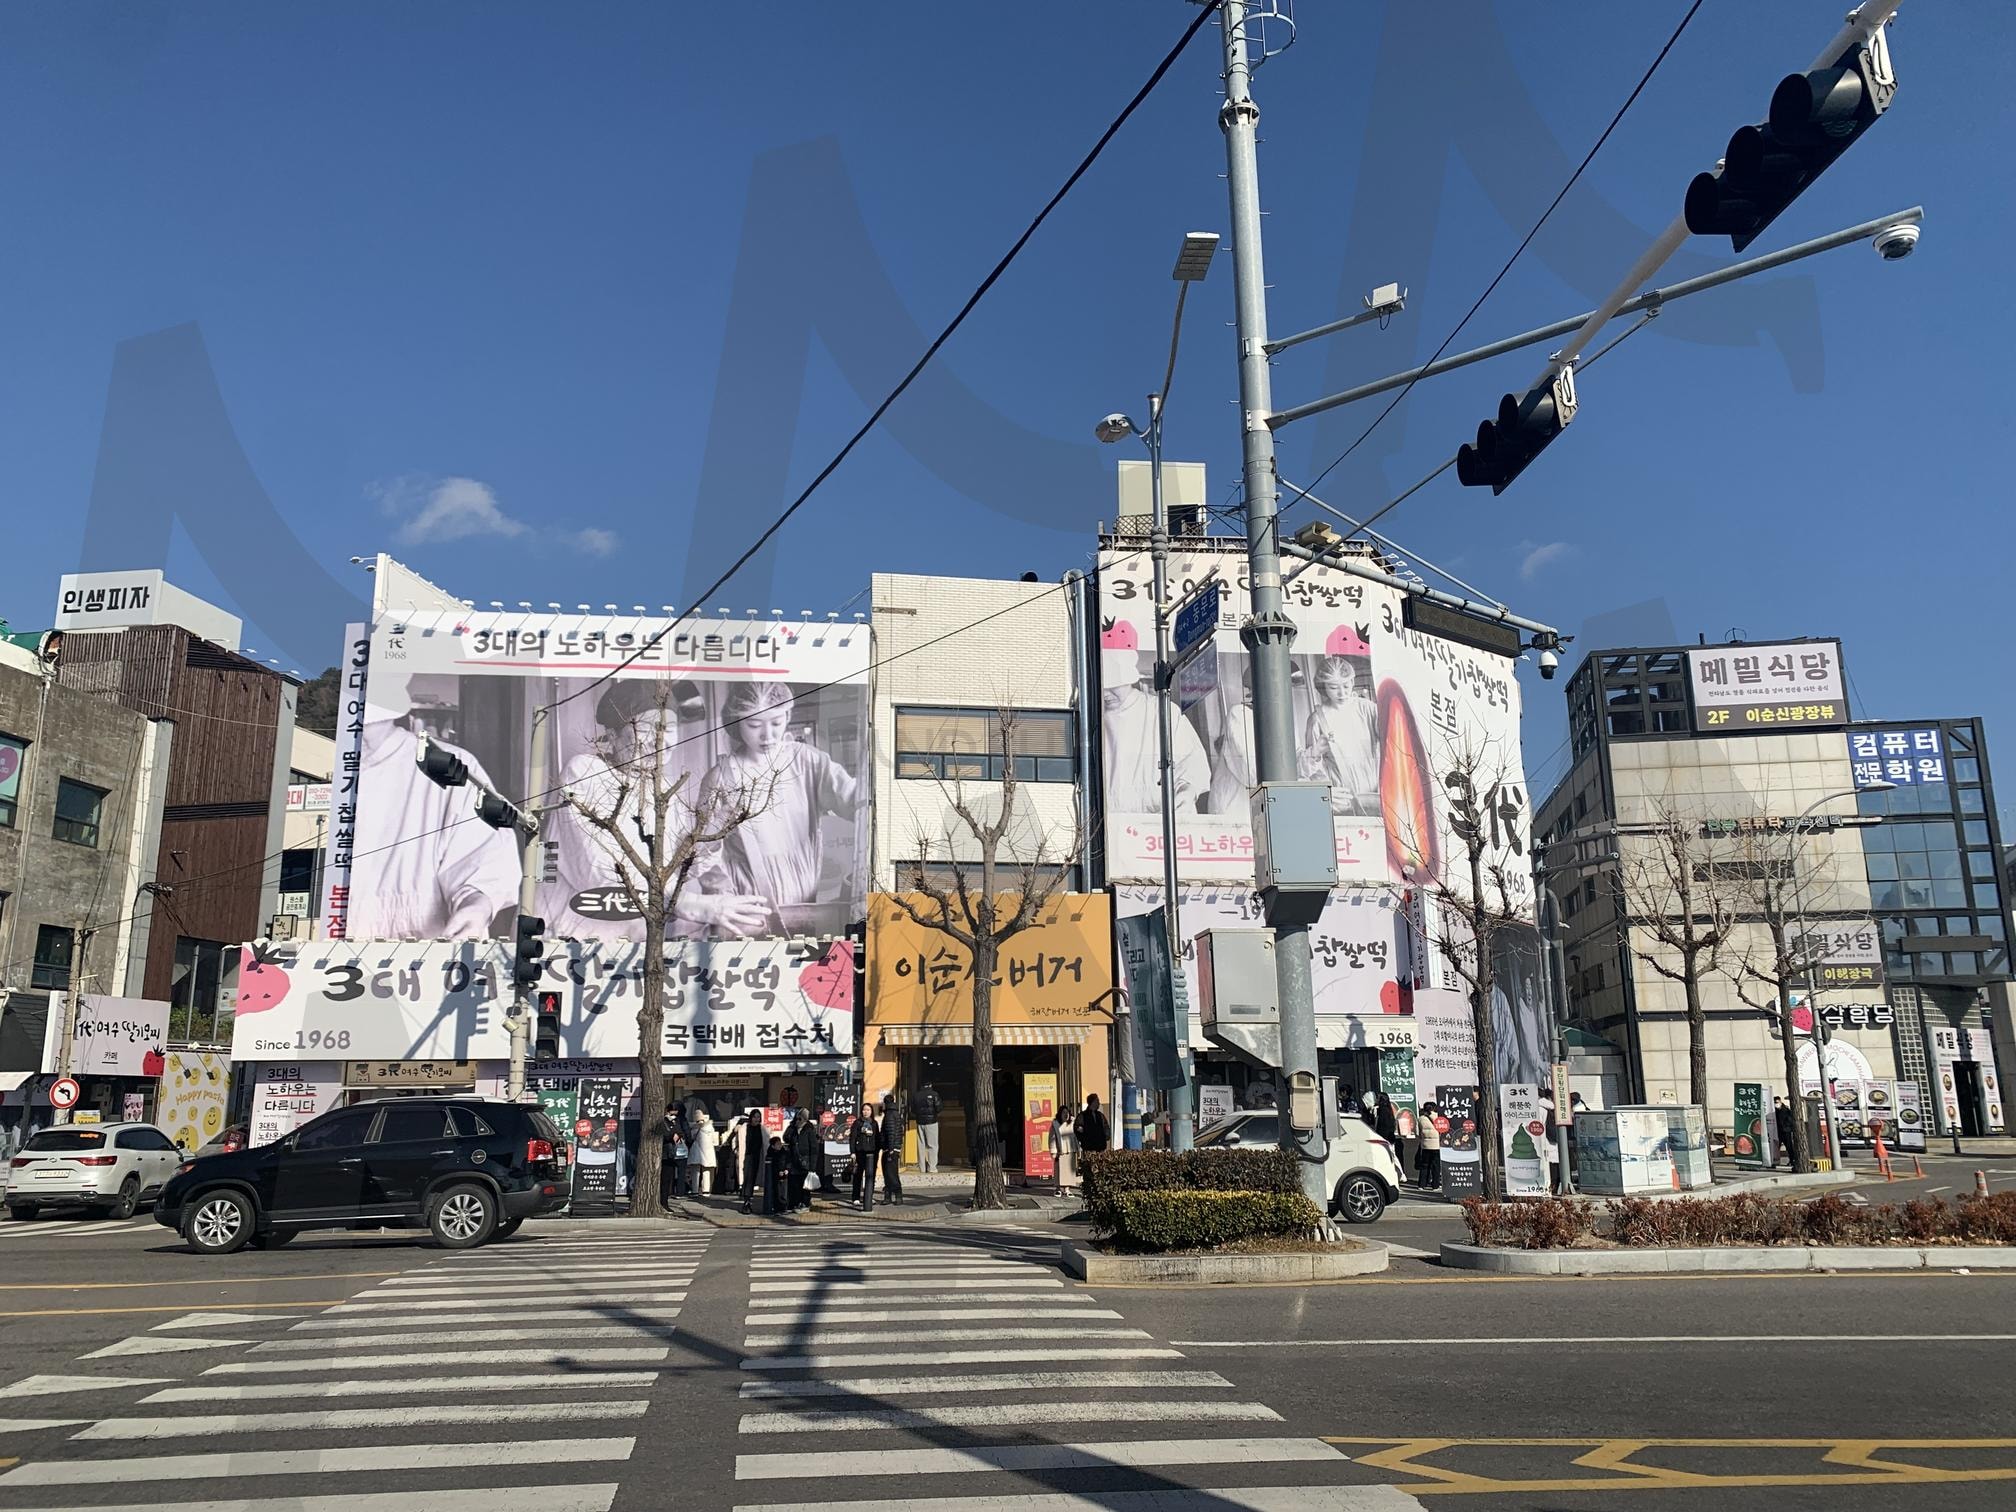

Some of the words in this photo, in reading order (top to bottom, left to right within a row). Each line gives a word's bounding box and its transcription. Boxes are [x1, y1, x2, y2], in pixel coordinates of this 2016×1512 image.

[63, 586, 150, 614] 인생피자
[383, 650, 407, 661] 1968
[473, 630, 544, 659] 3대의
[553, 631, 663, 661] 노하우는
[674, 634, 780, 664] 다릅니다
[349, 639, 370, 691] 3대
[1699, 652, 1831, 685] 메밀식당
[346, 700, 366, 739] 여수
[1430, 688, 1457, 731] 본점
[1707, 710, 1730, 725] 2F
[1746, 705, 1836, 723] 이순신광장뷰
[1853, 730, 1939, 757] 컴퓨터
[1445, 770, 1523, 857] 3代
[1201, 834, 1256, 861] 노하우
[326, 884, 350, 941] 본점
[323, 964, 422, 1002] 3대
[1821, 1003, 1895, 1025] 삼합당
[97, 1021, 119, 1038] 여수
[638, 1023, 746, 1050] 국택배
[756, 1021, 836, 1049] 접수처
[255, 1039, 291, 1051] Since
[293, 1029, 352, 1051] 1968
[1380, 1034, 1414, 1049] 1968
[104, 1050, 118, 1061] 카페
[267, 1066, 301, 1080] 3대의
[176, 1090, 202, 1106] Happy
[266, 1082, 317, 1096] 노하우는
[583, 1091, 618, 1107] 이순신
[827, 1091, 856, 1106] 이순신
[1509, 1088, 1529, 1097] 3代
[1439, 1093, 1472, 1109] 이순신
[1509, 1101, 1533, 1111] 해풍쑥
[1504, 1110, 1538, 1120] 아이스크림
[258, 1121, 278, 1130] 3대의
